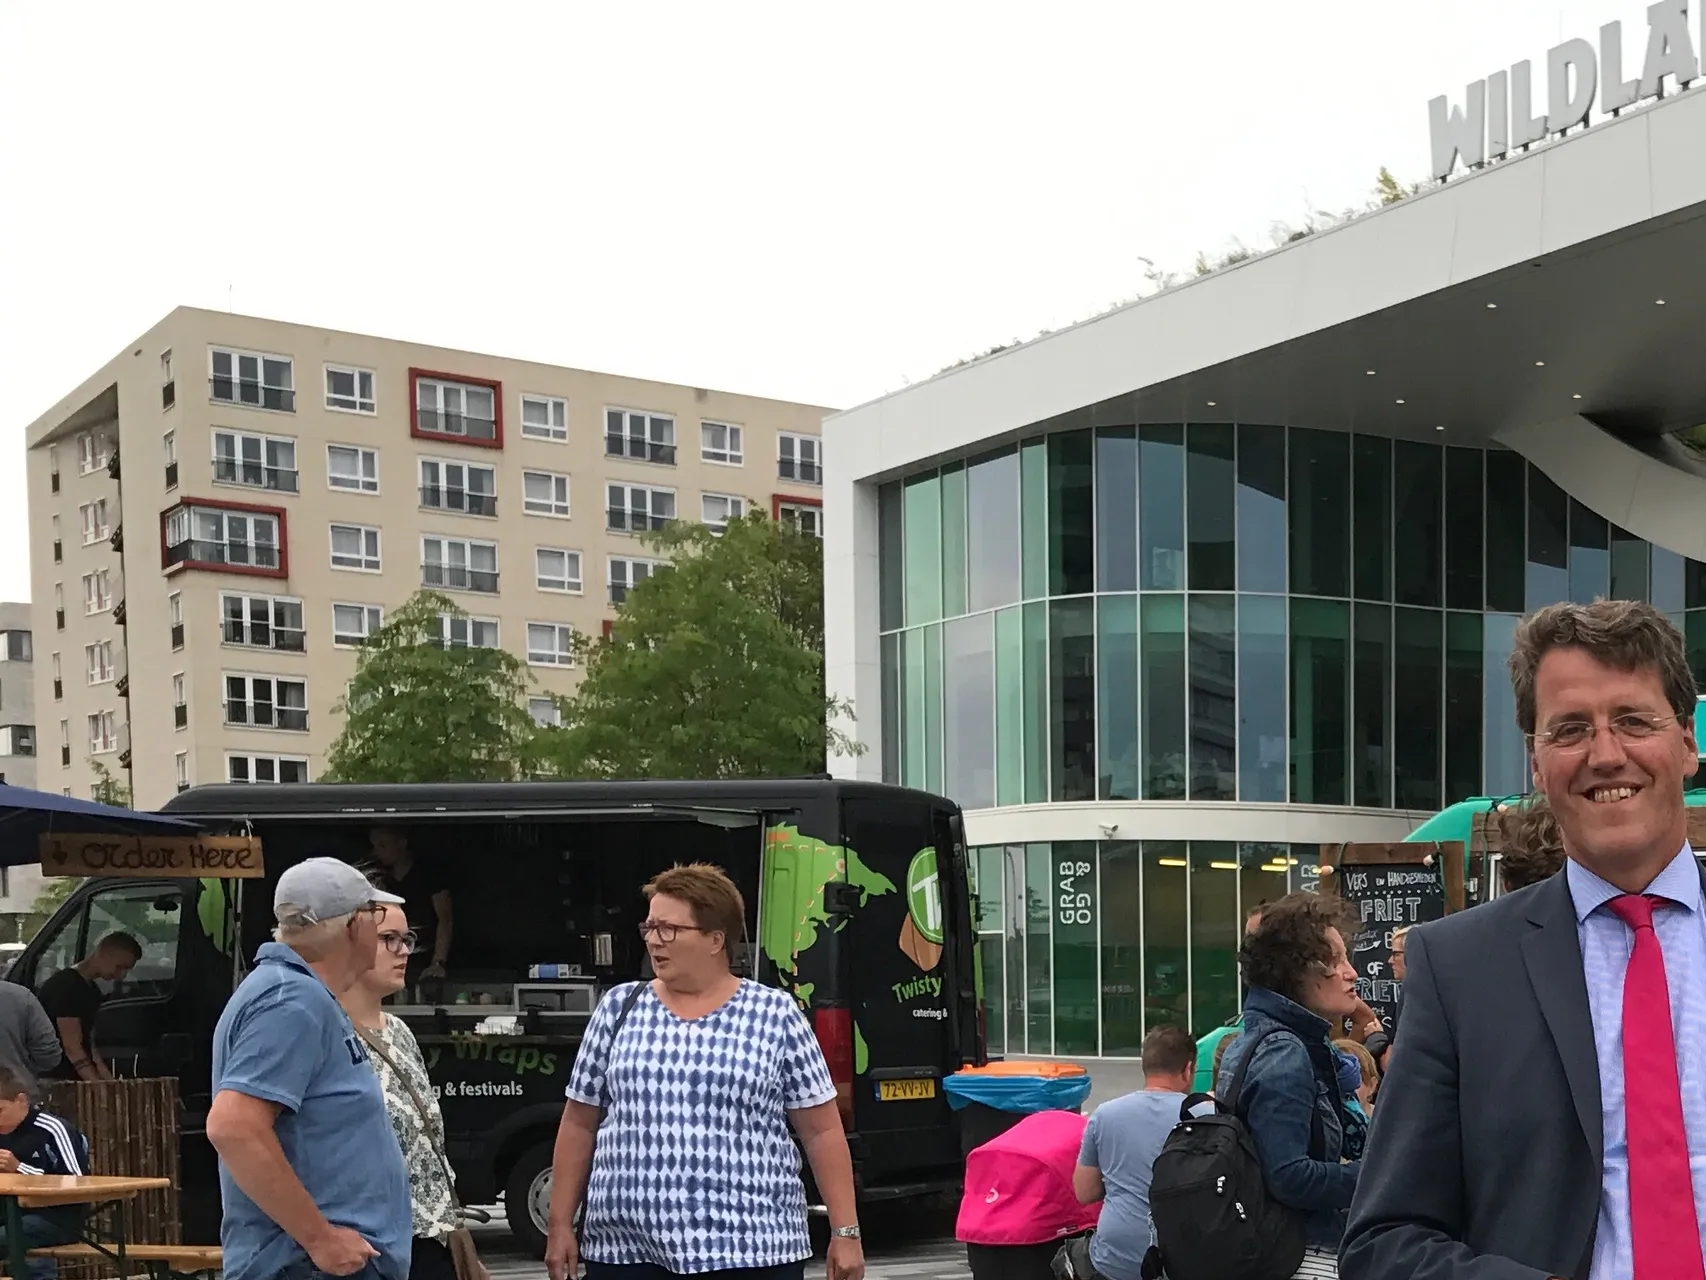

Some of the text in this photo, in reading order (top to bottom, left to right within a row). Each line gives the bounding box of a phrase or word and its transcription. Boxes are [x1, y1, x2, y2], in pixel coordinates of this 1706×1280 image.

[80, 837, 255, 869] Order Here
[1059, 861, 1075, 925] GRAB
[1345, 872, 1368, 891] VERS
[1076, 893, 1092, 925] GO
[1367, 961, 1384, 976] OF
[891, 974, 943, 1004] Twisty
[912, 1007, 942, 1021] catering
[445, 1081, 457, 1097] &
[459, 1080, 524, 1097] festivals
